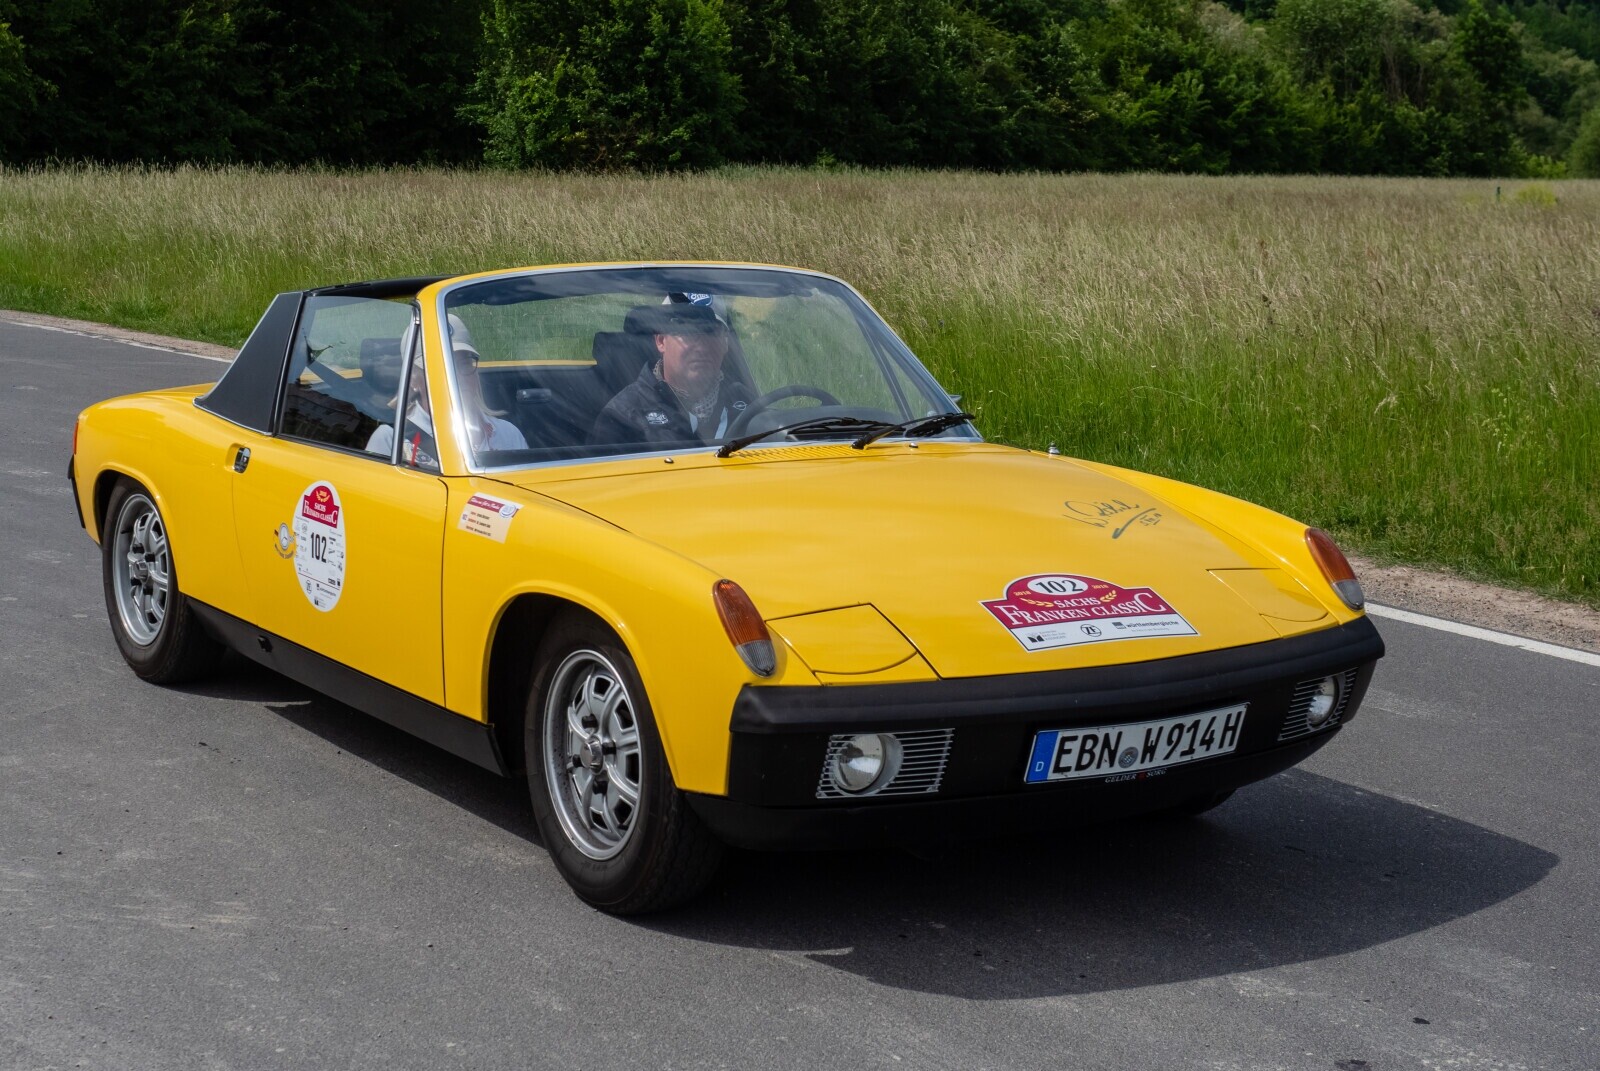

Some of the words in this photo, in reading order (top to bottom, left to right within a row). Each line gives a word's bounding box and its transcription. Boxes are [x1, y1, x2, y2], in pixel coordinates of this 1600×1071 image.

[310, 532, 327, 563] 102
[1035, 579, 1084, 594] 102
[994, 605, 1091, 626] FRANKEN
[1091, 592, 1167, 617] CLASSIC
[1053, 597, 1101, 609] SACHS
[1052, 731, 1123, 773] EBN
[1035, 761, 1045, 772] D
